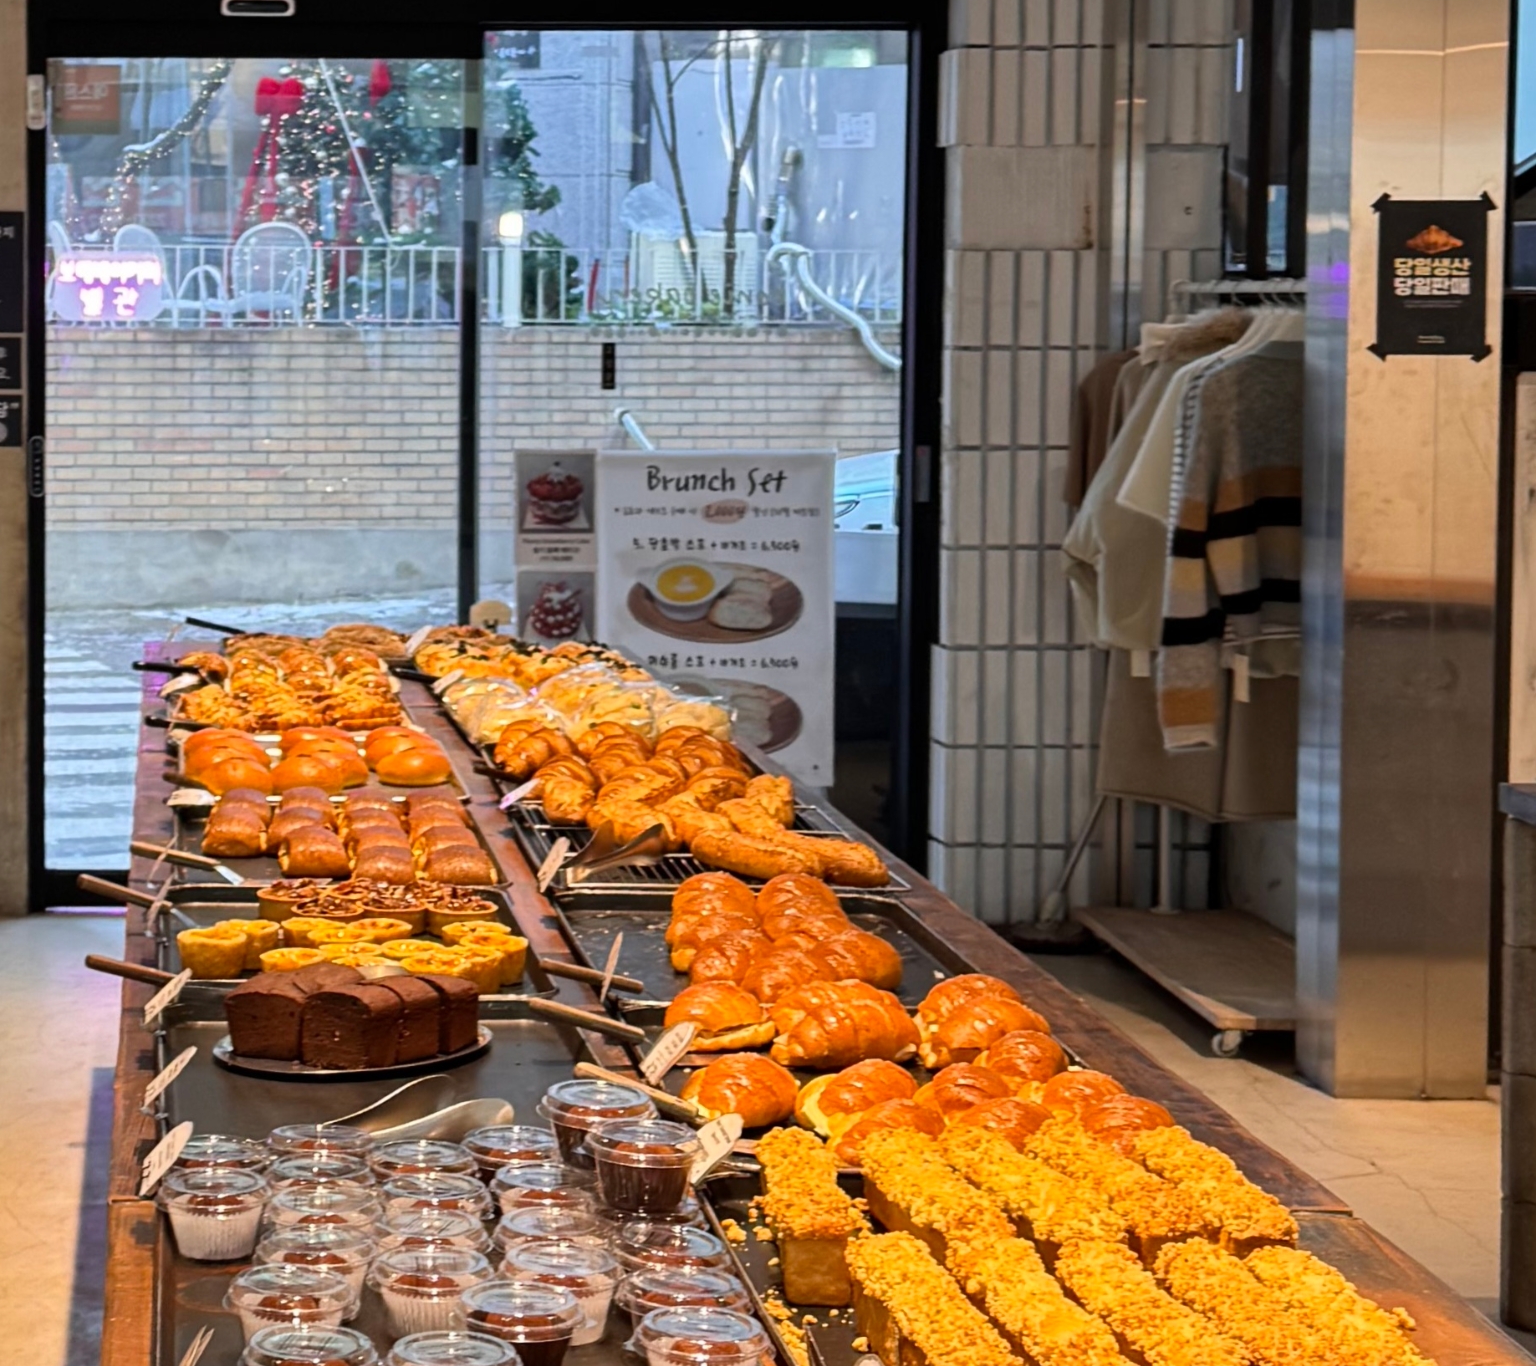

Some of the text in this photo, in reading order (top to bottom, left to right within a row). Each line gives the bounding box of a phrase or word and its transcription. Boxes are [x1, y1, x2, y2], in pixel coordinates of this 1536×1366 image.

[1393, 257, 1472, 276] 당일생산
[1393, 277, 1471, 296] 당일판매
[646, 465, 788, 497] Brunch Set
